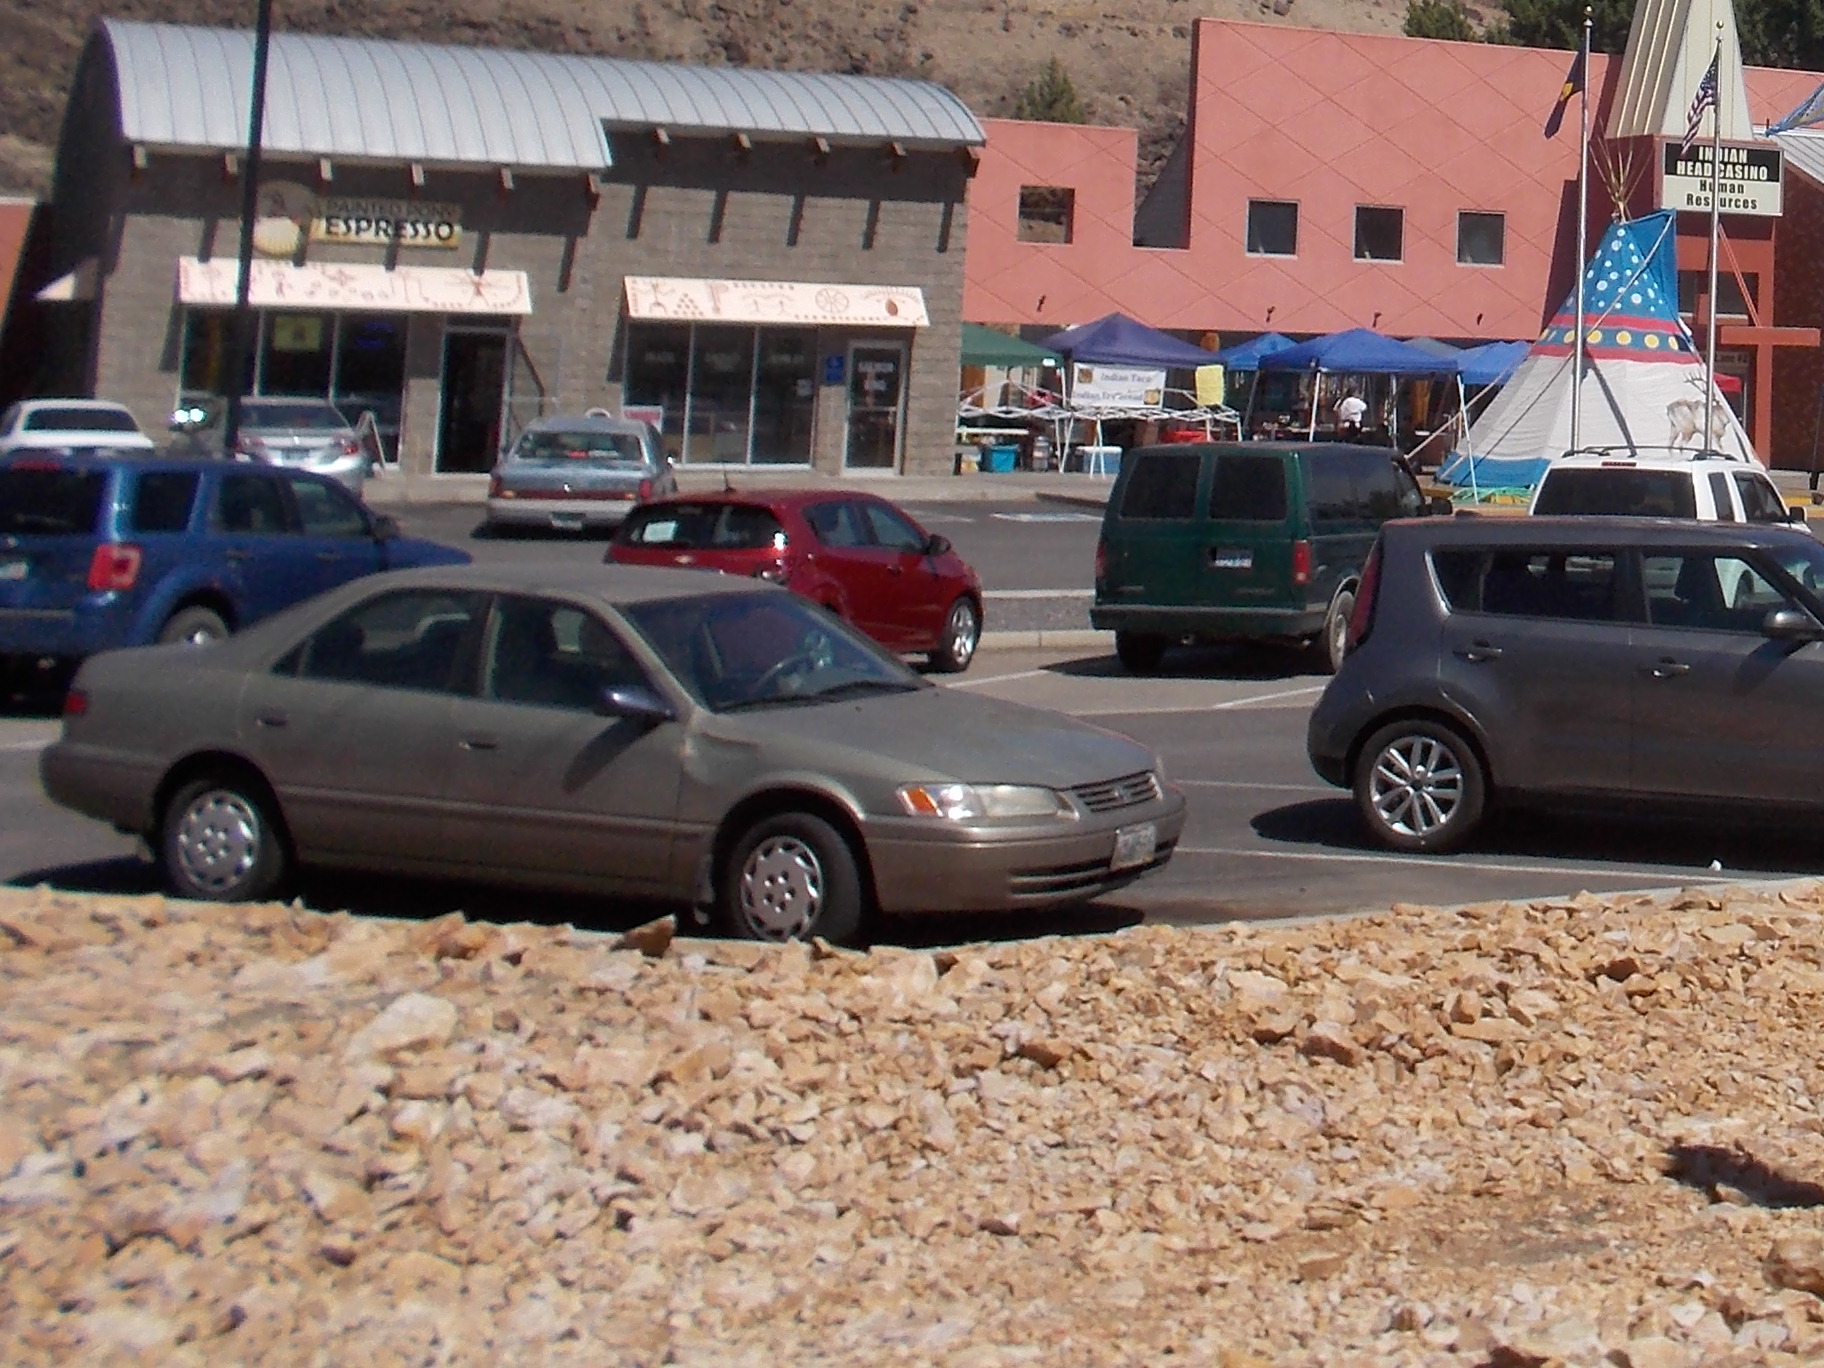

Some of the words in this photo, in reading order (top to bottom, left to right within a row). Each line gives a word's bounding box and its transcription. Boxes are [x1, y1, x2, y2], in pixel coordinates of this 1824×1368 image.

[1676, 160, 1713, 177] HEAD
[1717, 163, 1769, 181] CASINO
[1686, 193, 1758, 210] Resurces
[325, 216, 455, 241] ESPRESSO
